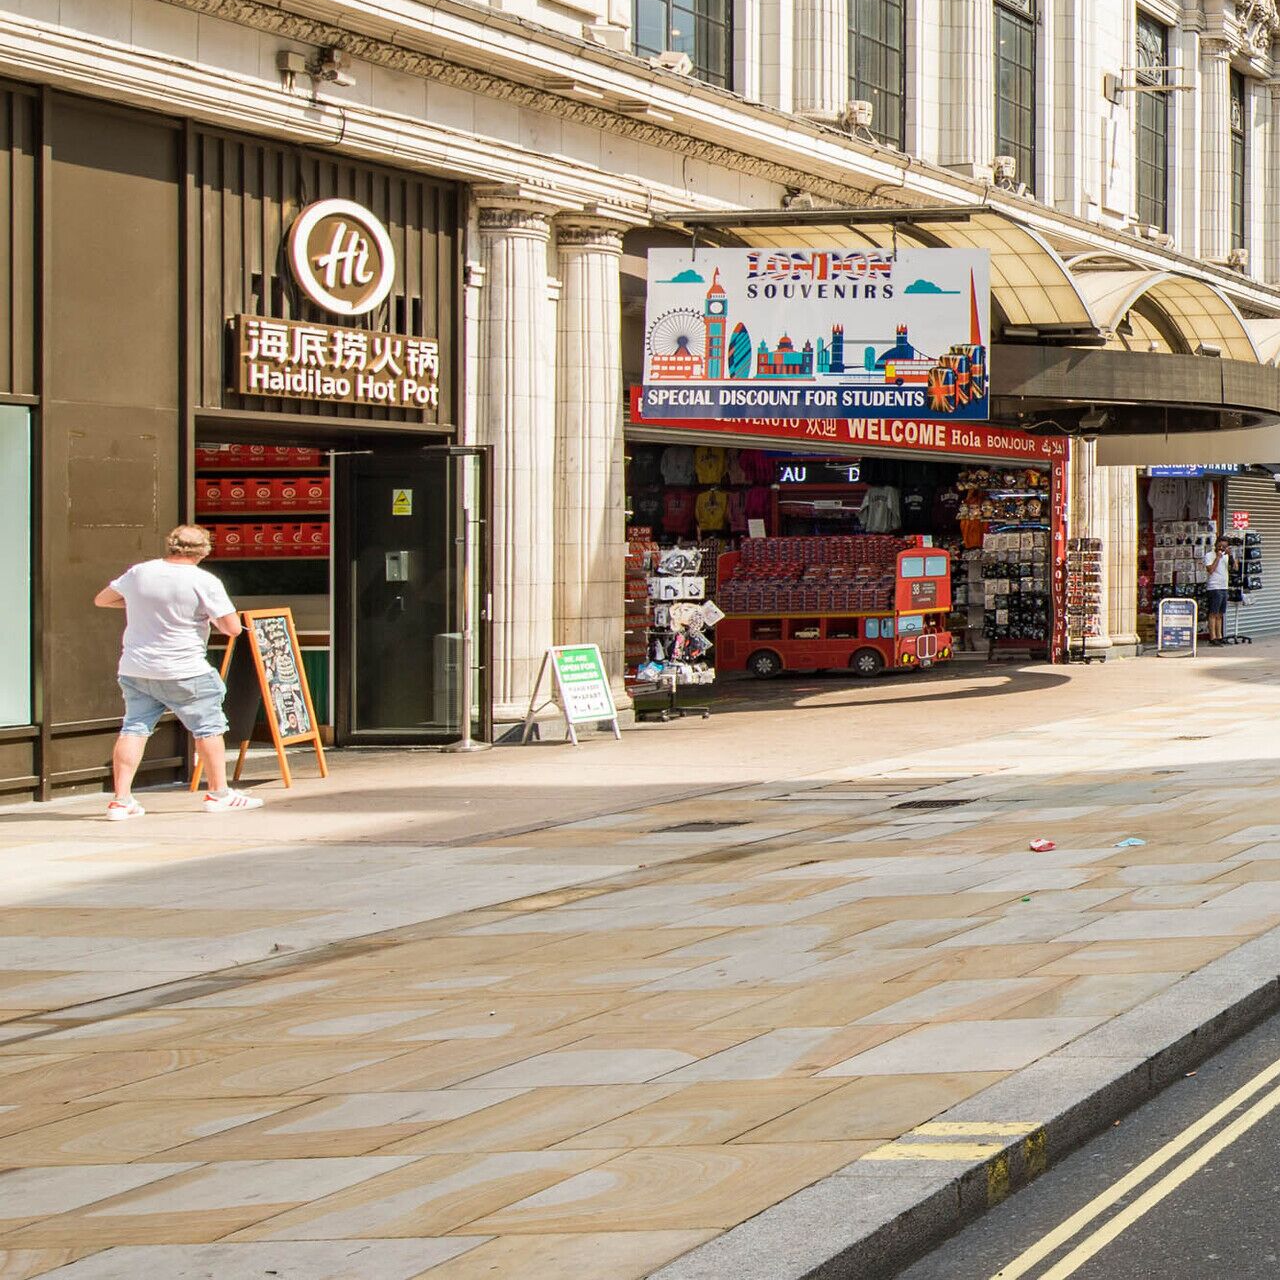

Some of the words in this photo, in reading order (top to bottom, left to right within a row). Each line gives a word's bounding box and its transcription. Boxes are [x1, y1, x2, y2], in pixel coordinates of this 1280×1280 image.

[318, 222, 374, 288] Hi
[747, 251, 894, 281] LONDON
[746, 283, 894, 299] SOUVENIRS
[248, 320, 439, 378] 海底捞火锅
[249, 362, 351, 397] Haidilao
[356, 373, 397, 402] Hot
[402, 378, 439, 405] Pot
[647, 389, 715, 406] SPECIAL
[719, 389, 801, 407] DISCOUNT
[805, 390, 838, 407] FOR
[842, 390, 925, 407] STUDENTS
[714, 418, 800, 429] NVENUTO
[847, 418, 947, 447] WELCOME
[951, 429, 981, 448] Hola
[986, 435, 1036, 452] BONJOUR
[780, 466, 806, 482] AU
[912, 583, 920, 595] 38
[1054, 556, 1062, 657] SOUVENIR
